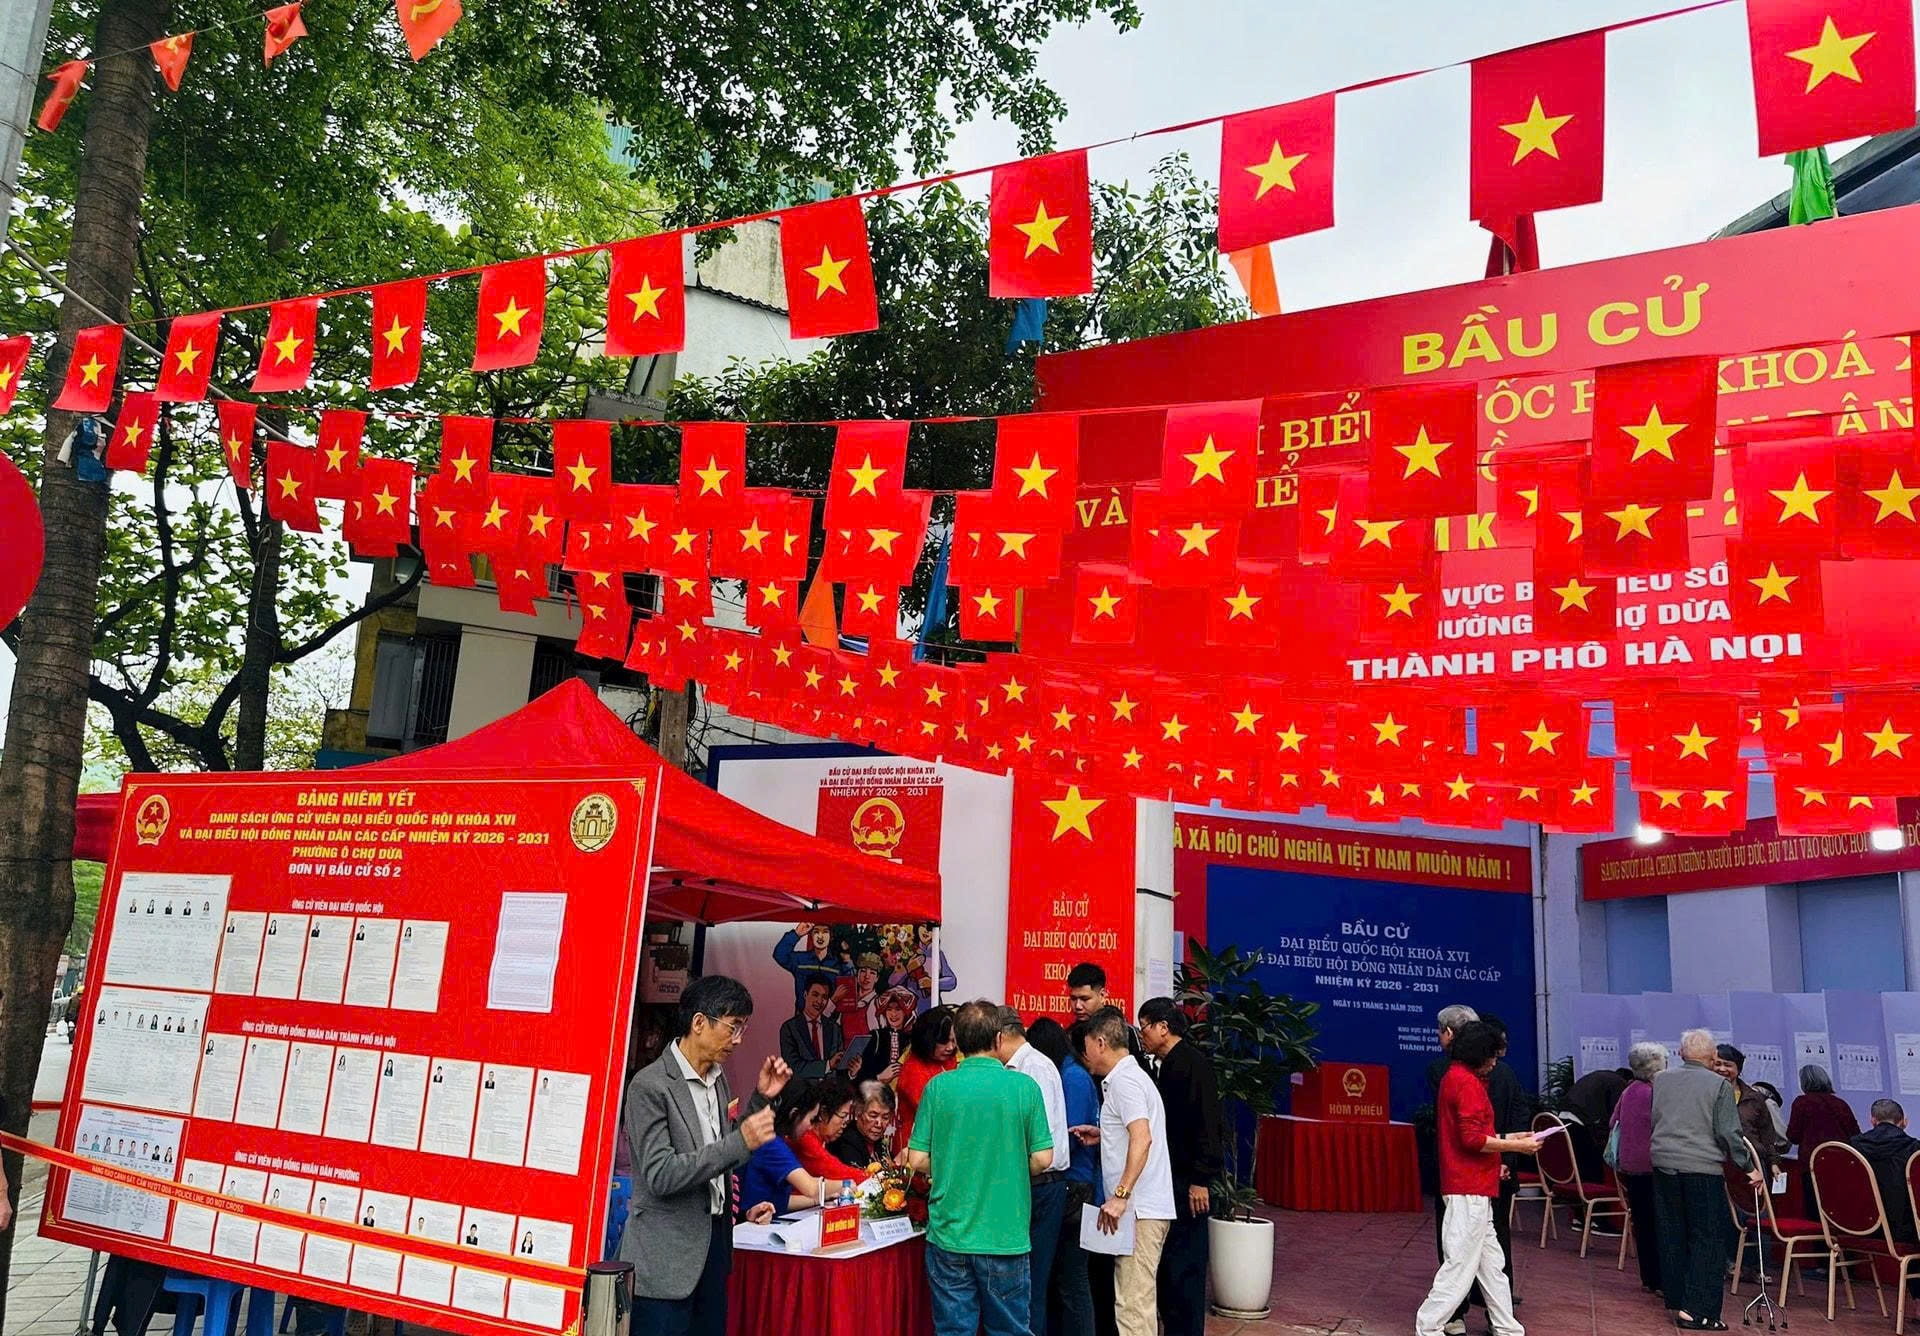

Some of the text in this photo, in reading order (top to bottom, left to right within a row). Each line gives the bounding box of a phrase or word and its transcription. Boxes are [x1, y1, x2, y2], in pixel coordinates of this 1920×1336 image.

[1402, 275, 1709, 375] BẦU CỬ
[1075, 487, 1128, 529] VÀ
[1441, 583, 1505, 609] VỰC
[1658, 598, 1731, 625] DỪA
[1346, 652, 1495, 681] THÀNH
[1624, 635, 1694, 666] HÀ
[297, 788, 416, 806] BẢNG NIÊM YẾT
[830, 787, 929, 798] NHIỆM KỲ 2026 2031
[292, 845, 403, 860] PHƯỜNG Ô CHỢ DỪA
[1188, 825, 1210, 851] XÃ
[1215, 828, 1242, 858] HỘI
[1247, 830, 1279, 858] CHỦ
[1284, 838, 1334, 865] NGHĨA
[1338, 841, 1370, 871] VIỆT
[1375, 848, 1411, 871] NAM
[1416, 850, 1462, 876] MUÔN
[1466, 854, 1501, 880] NĂM
[1506, 860, 1511, 880] !
[288, 861, 401, 877] ĐƠN VỊ BẦU CỬ SỐ 2
[1053, 892, 1089, 916] BẦU CỬ
[1024, 921, 1117, 953] ĐẠI BIỂU QUỐC HỘI
[1341, 919, 1410, 939] BẦU CỬ
[1280, 933, 1469, 963] ĐẠI BIỂU QUỐC HỘI KHOÁ XVI
[1268, 953, 1290, 968] ĐẠI
[1294, 949, 1322, 968] BIỂU
[1326, 957, 1348, 972] HỘI
[1352, 956, 1386, 974] ĐỒNG
[1389, 961, 1423, 976] NHÂN
[1427, 964, 1451, 978] DÂN
[1454, 966, 1477, 980] CÁC
[1479, 966, 1501, 982] CẤP
[1315, 975, 1439, 993] NHIỆM KỲ 2026 2031
[1013, 989, 1026, 1011] VÀ
[1029, 994, 1048, 1015] ĐẠI
[1329, 1101, 1352, 1115] HÒM
